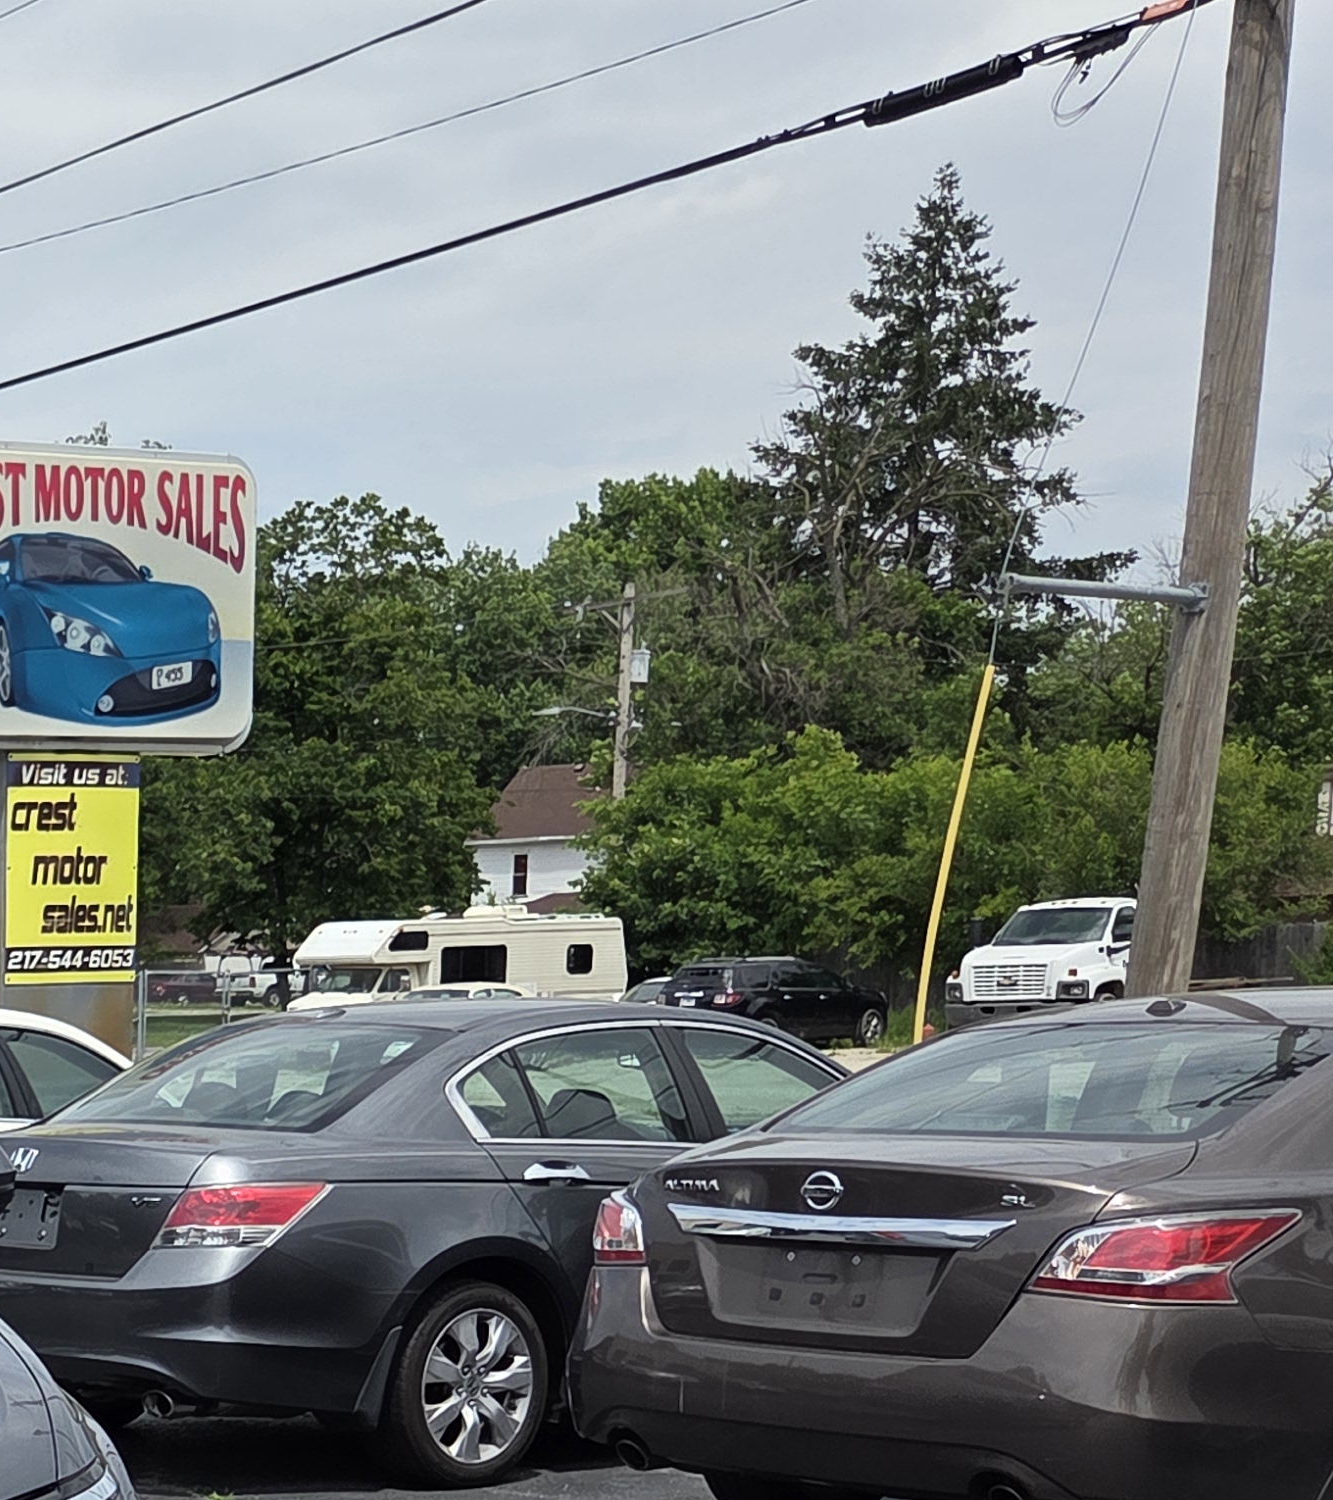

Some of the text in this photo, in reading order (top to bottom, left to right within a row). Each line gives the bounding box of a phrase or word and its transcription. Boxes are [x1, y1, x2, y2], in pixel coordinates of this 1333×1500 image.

[34, 463, 148, 530] MOTOR
[156, 470, 246, 574] SALES
[21, 763, 129, 786] Visit us at:
[10, 792, 77, 832] crest
[31, 846, 108, 885] motor
[41, 894, 133, 934] sales.net
[7, 948, 134, 970] 217-544-6053
